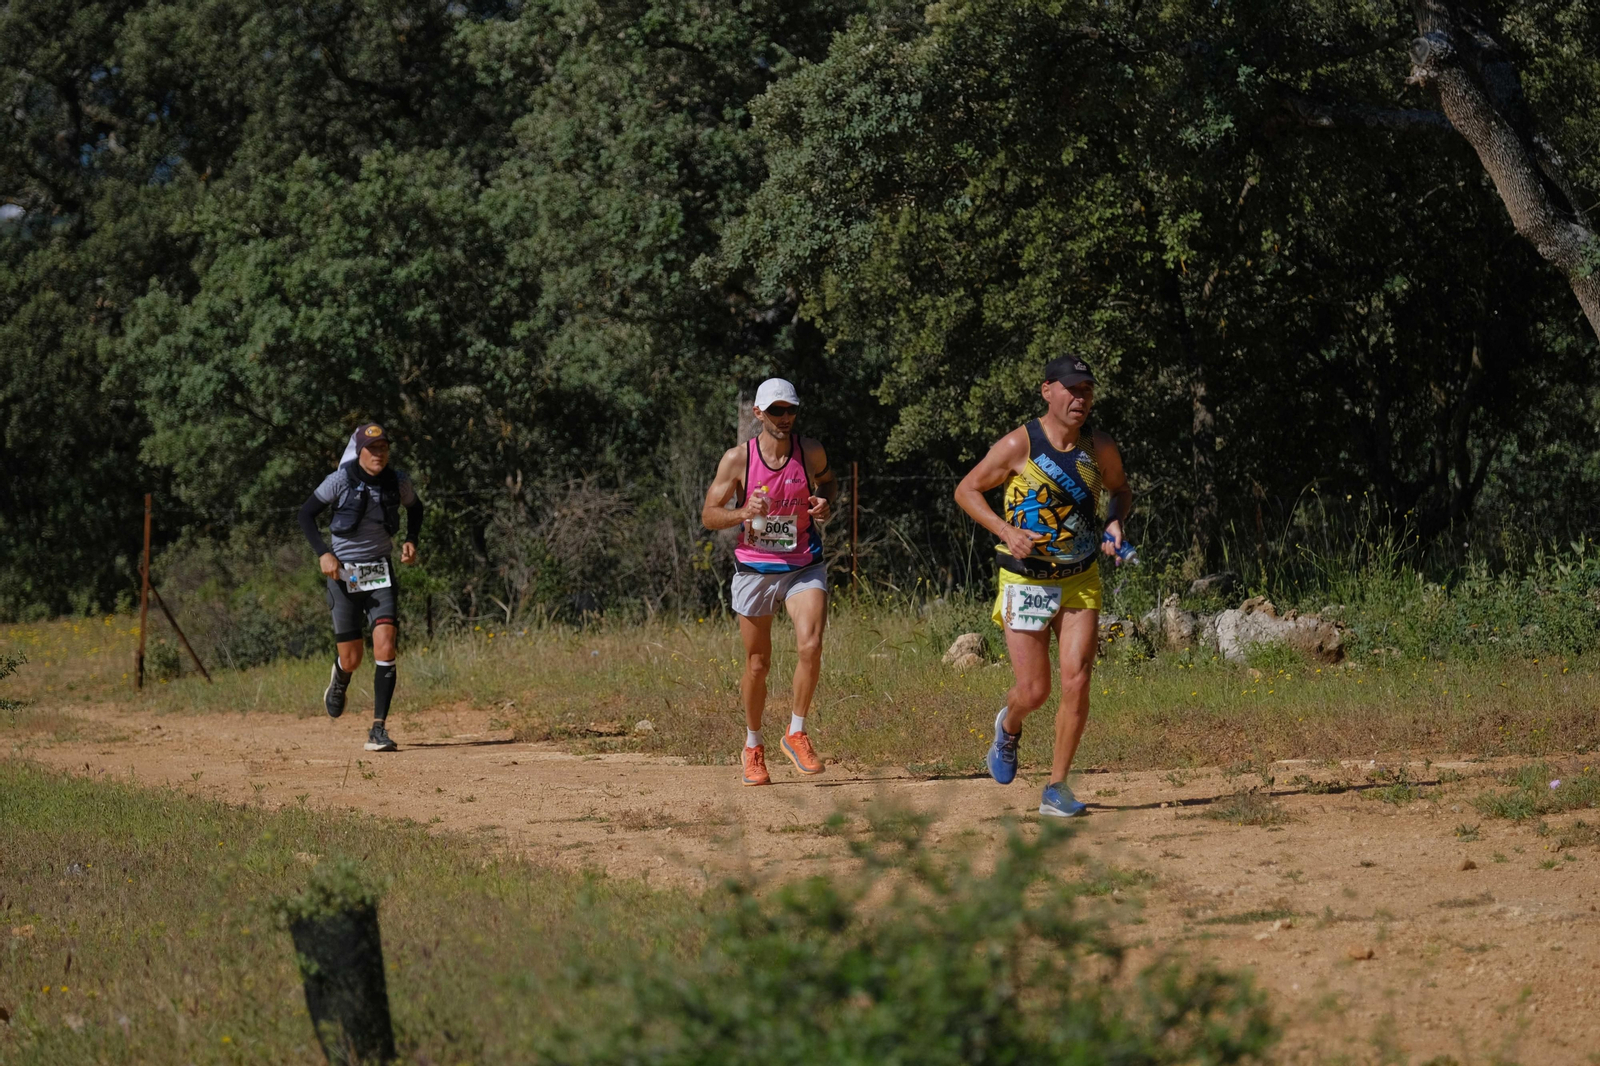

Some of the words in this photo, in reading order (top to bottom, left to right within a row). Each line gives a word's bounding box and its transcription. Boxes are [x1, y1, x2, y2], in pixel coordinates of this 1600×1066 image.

[1033, 453, 1088, 504] NORTRAIL
[775, 498, 806, 507] TRAIL
[766, 522, 789, 533] 606
[359, 564, 386, 579] 1345
[1024, 563, 1083, 579] naked
[1024, 594, 1053, 609] 407
